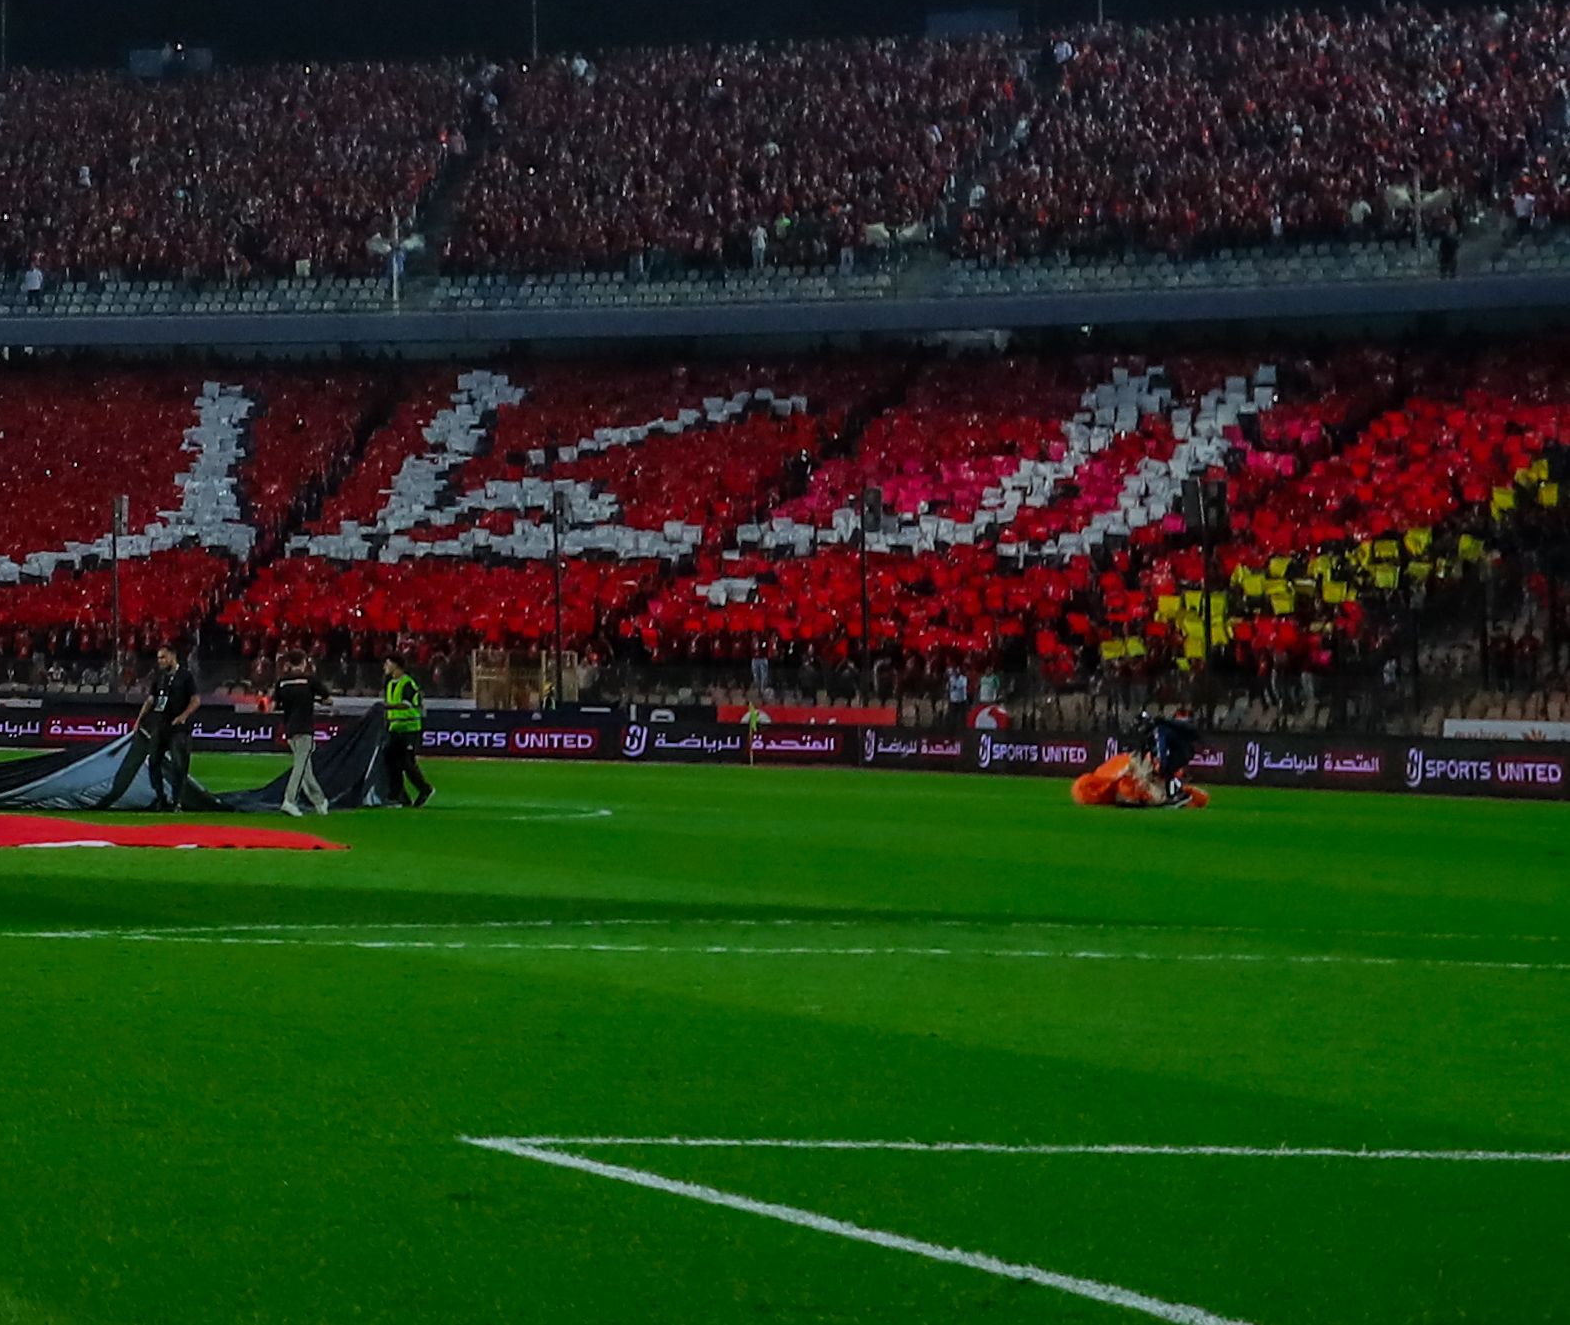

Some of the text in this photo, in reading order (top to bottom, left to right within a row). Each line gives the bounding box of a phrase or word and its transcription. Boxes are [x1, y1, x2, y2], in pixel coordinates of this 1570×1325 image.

[49, 719, 129, 737] المتحدة
[190, 722, 273, 743] للرياضة
[421, 731, 593, 750] SPORTS UNITED
[654, 732, 741, 753] للرياضة
[751, 733, 835, 752] المتحدة
[992, 743, 1038, 762] SPORTS
[1042, 745, 1088, 764] UNITED
[1263, 751, 1318, 775] للرياضة
[1323, 752, 1380, 773] المتحدة
[1424, 759, 1491, 780] SPORTS
[1497, 761, 1562, 783] UNITED
